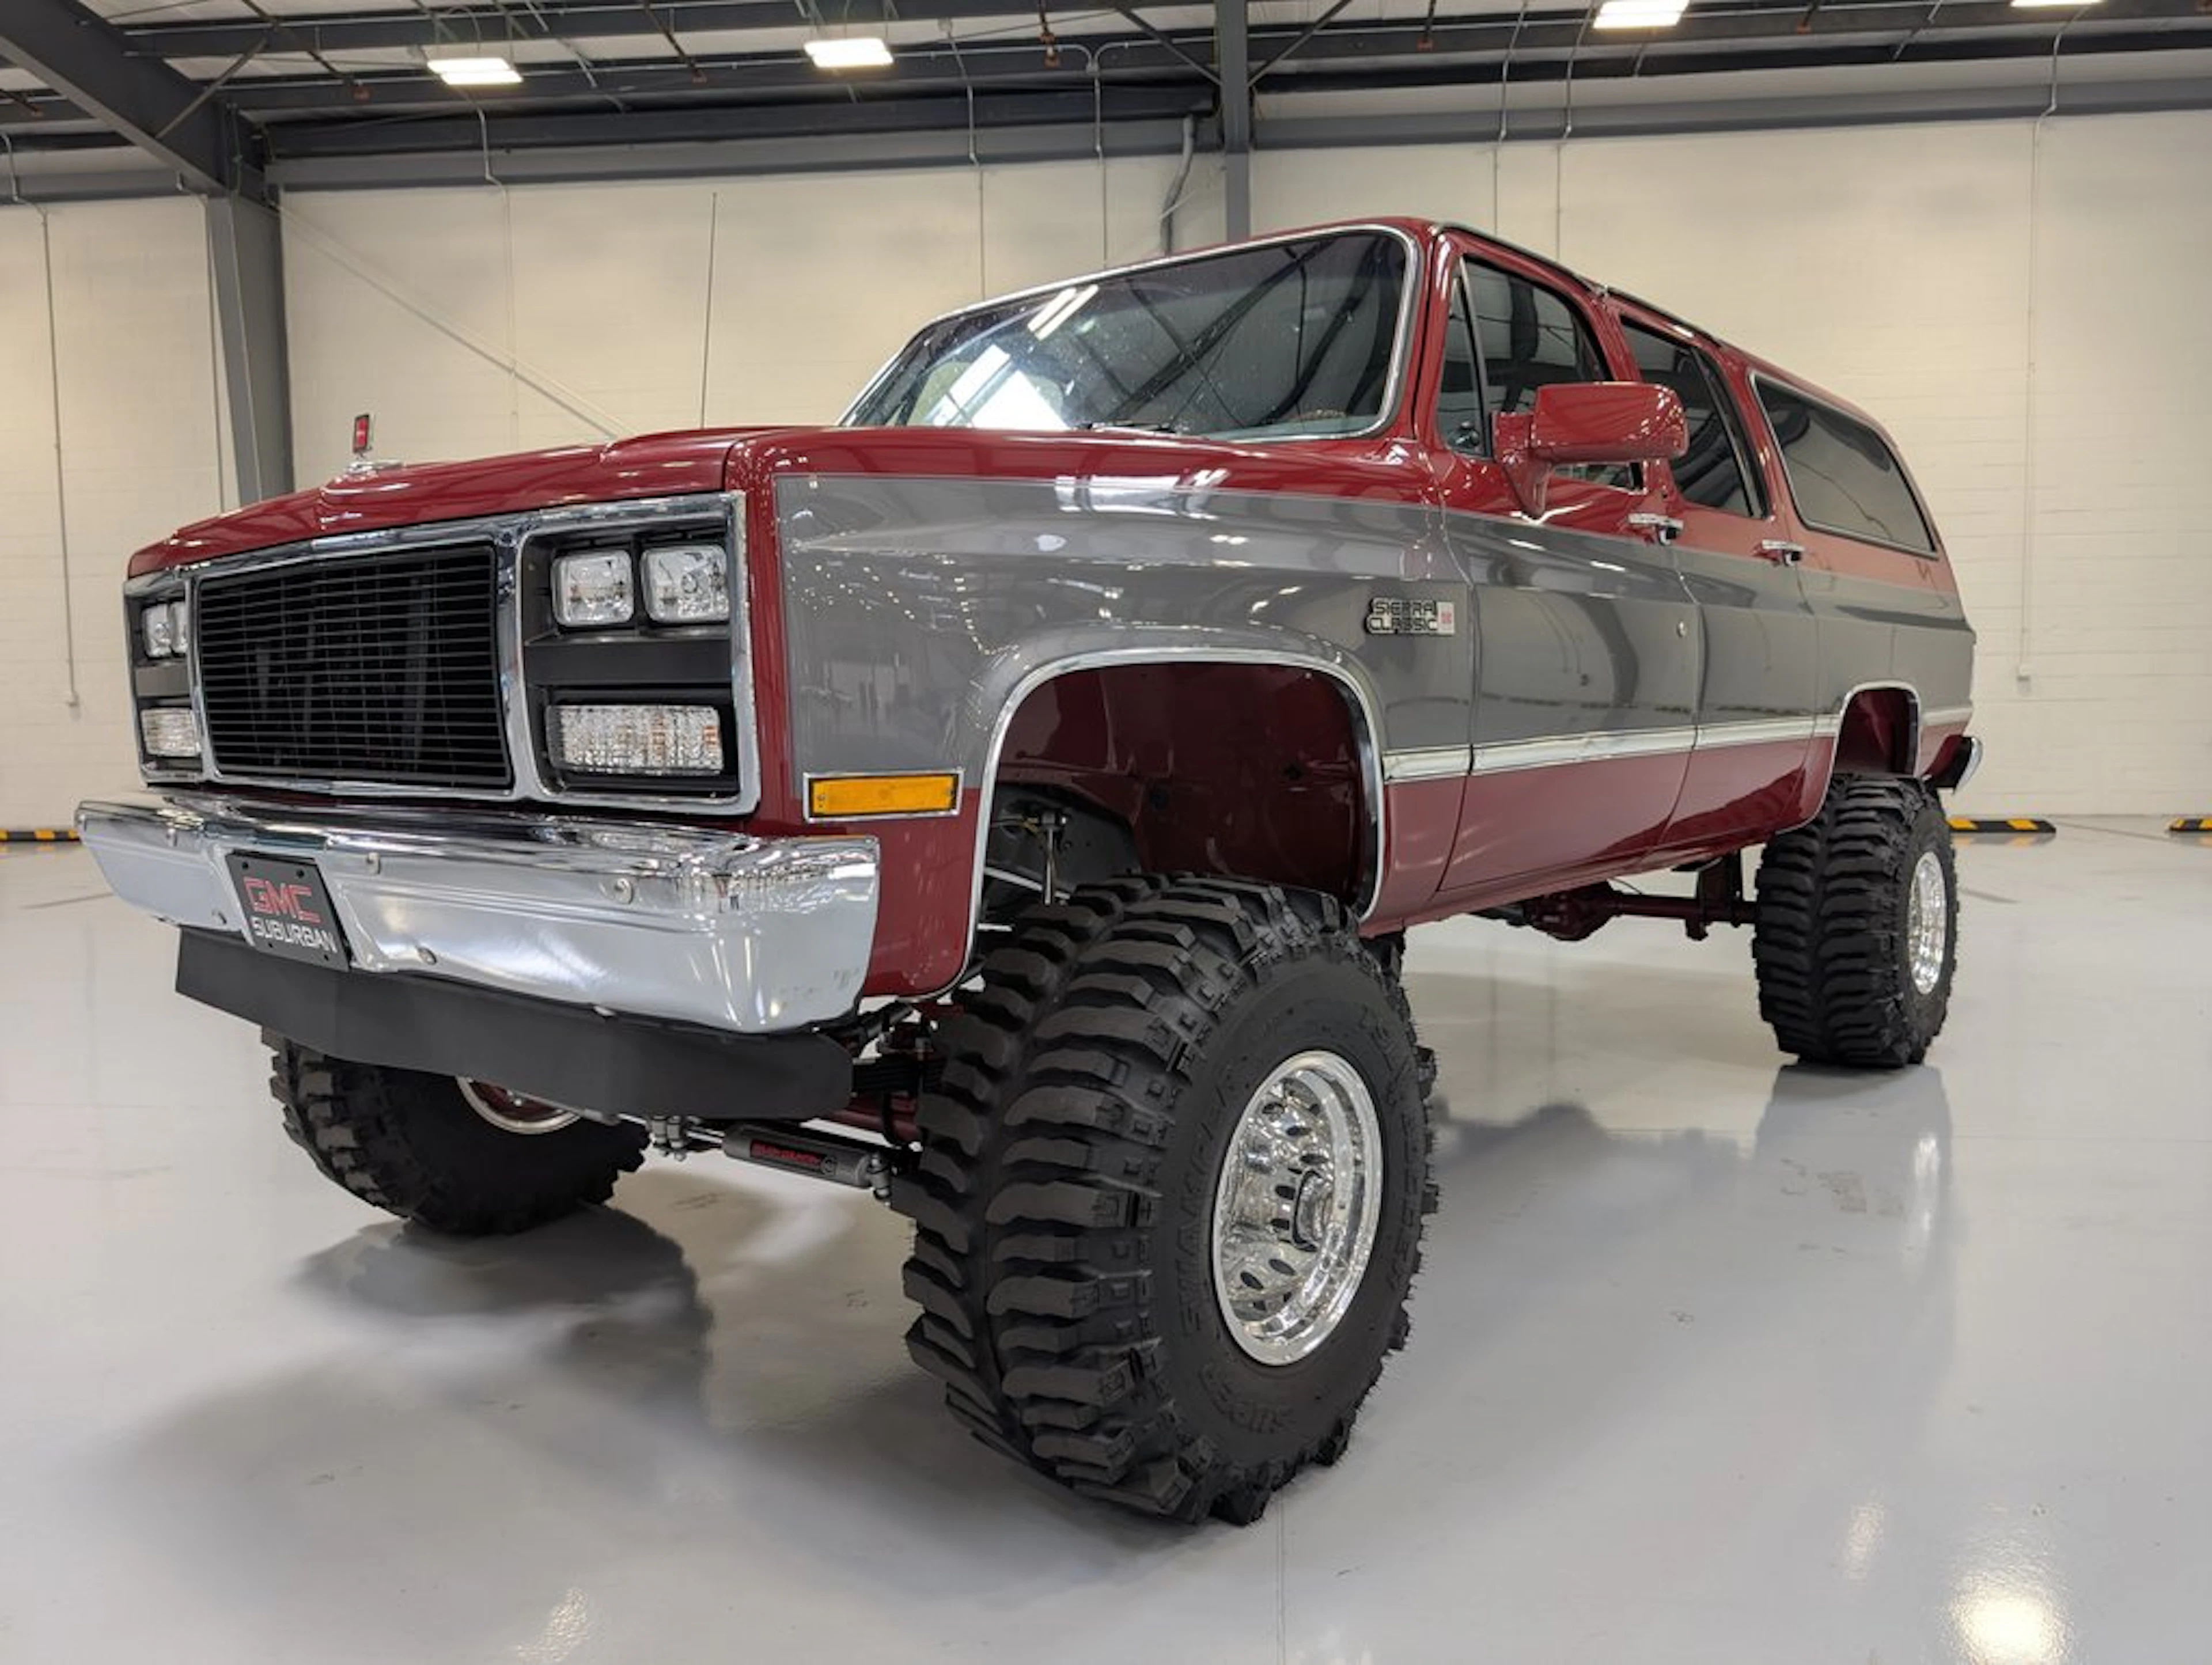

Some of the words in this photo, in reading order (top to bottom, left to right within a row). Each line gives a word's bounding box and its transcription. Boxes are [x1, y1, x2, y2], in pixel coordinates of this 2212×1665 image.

[1373, 598, 1437, 615] SIERRA
[1367, 615, 1438, 633] CLASSIC
[243, 877, 321, 924] GMC
[250, 916, 338, 953] SUBURBAN
